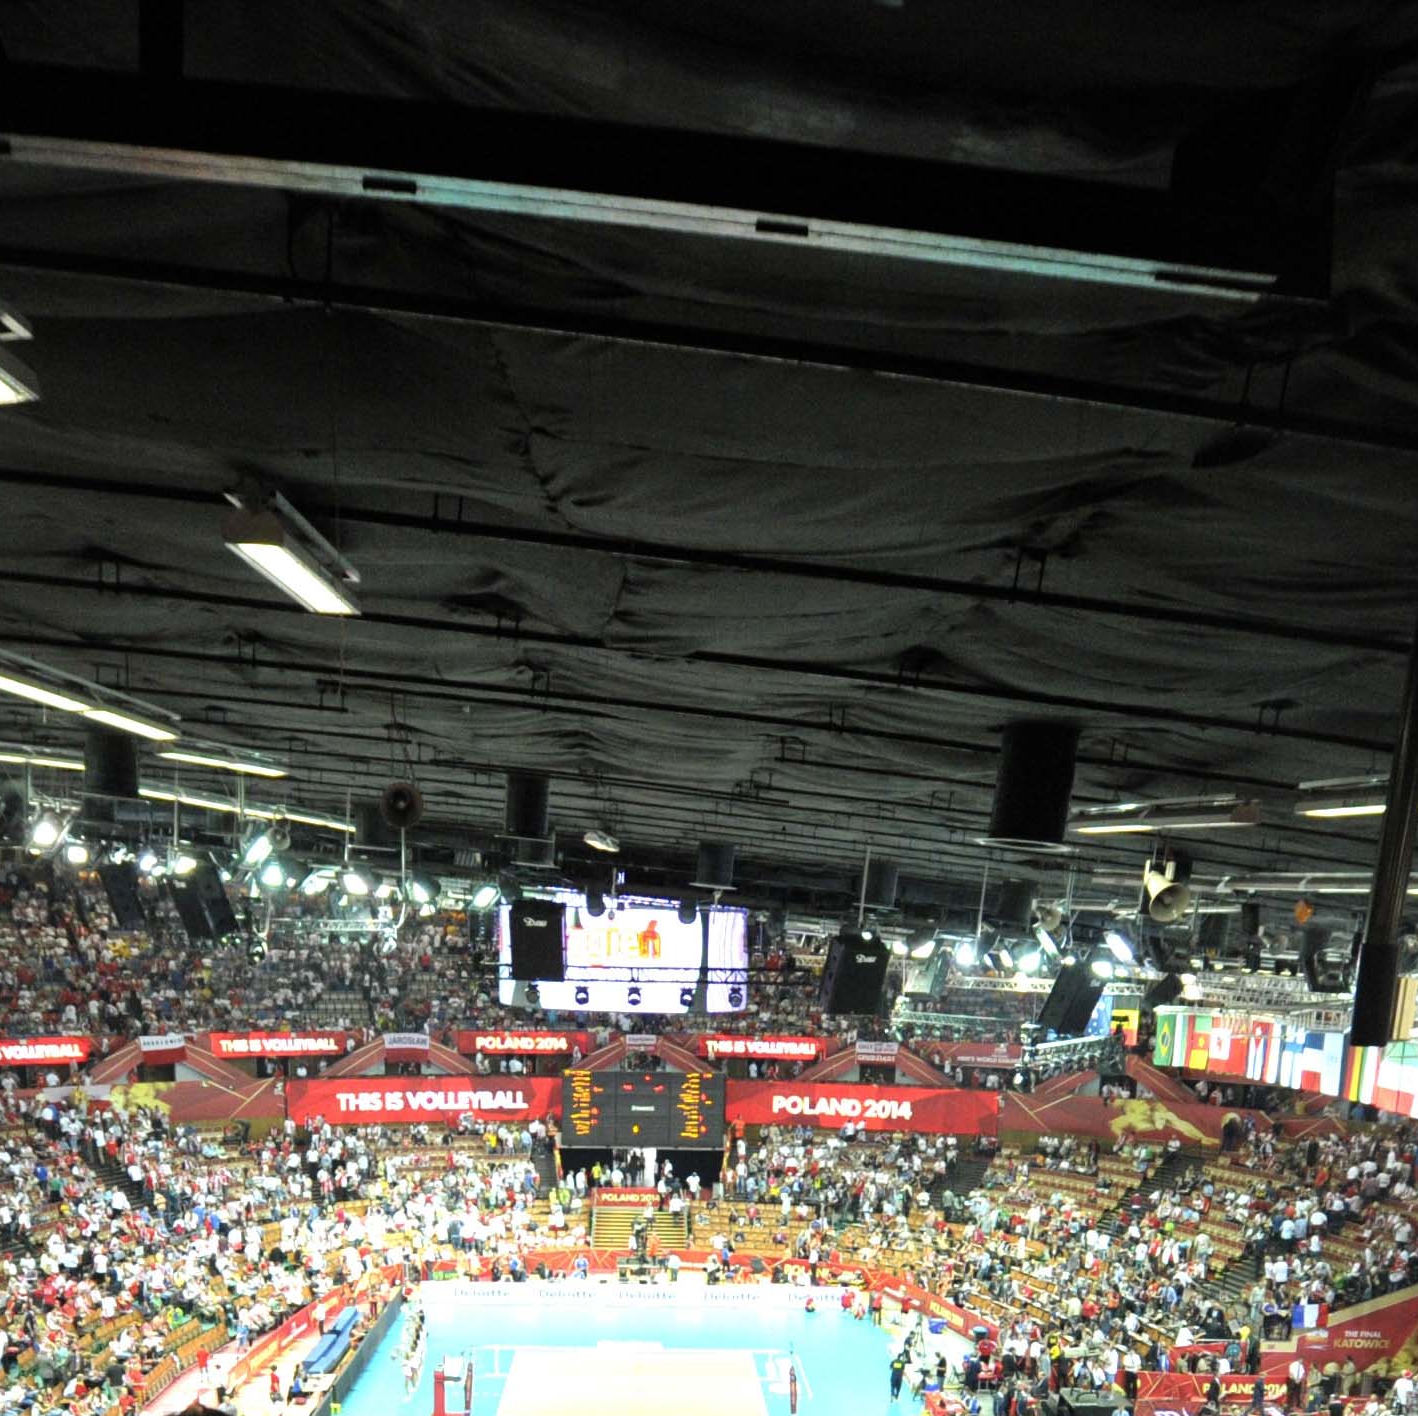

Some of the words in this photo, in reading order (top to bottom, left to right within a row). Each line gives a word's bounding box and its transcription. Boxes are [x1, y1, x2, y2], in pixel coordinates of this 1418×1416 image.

[219, 1038, 248, 1052] THIS
[248, 1038, 261, 1053] IS
[261, 1037, 338, 1052] VOLLEYBALL
[475, 1036, 535, 1050] POLAND
[535, 1037, 567, 1050] 2014
[705, 1039, 735, 1054] THIS
[735, 1040, 746, 1053] IS
[746, 1040, 816, 1055] VOLLEYBALL
[1, 1043, 83, 1060] VOLLEYBALL
[336, 1092, 382, 1112] THIS
[384, 1092, 403, 1111] IS
[405, 1090, 530, 1110] VOLLEYBALL
[772, 1095, 862, 1117] POLAND
[863, 1099, 913, 1120] 2014
[601, 1193, 640, 1202] POLAND
[1344, 1330, 1358, 1338] THE
[1359, 1330, 1381, 1338] FINAL
[1333, 1339, 1390, 1349] KATOWICE
